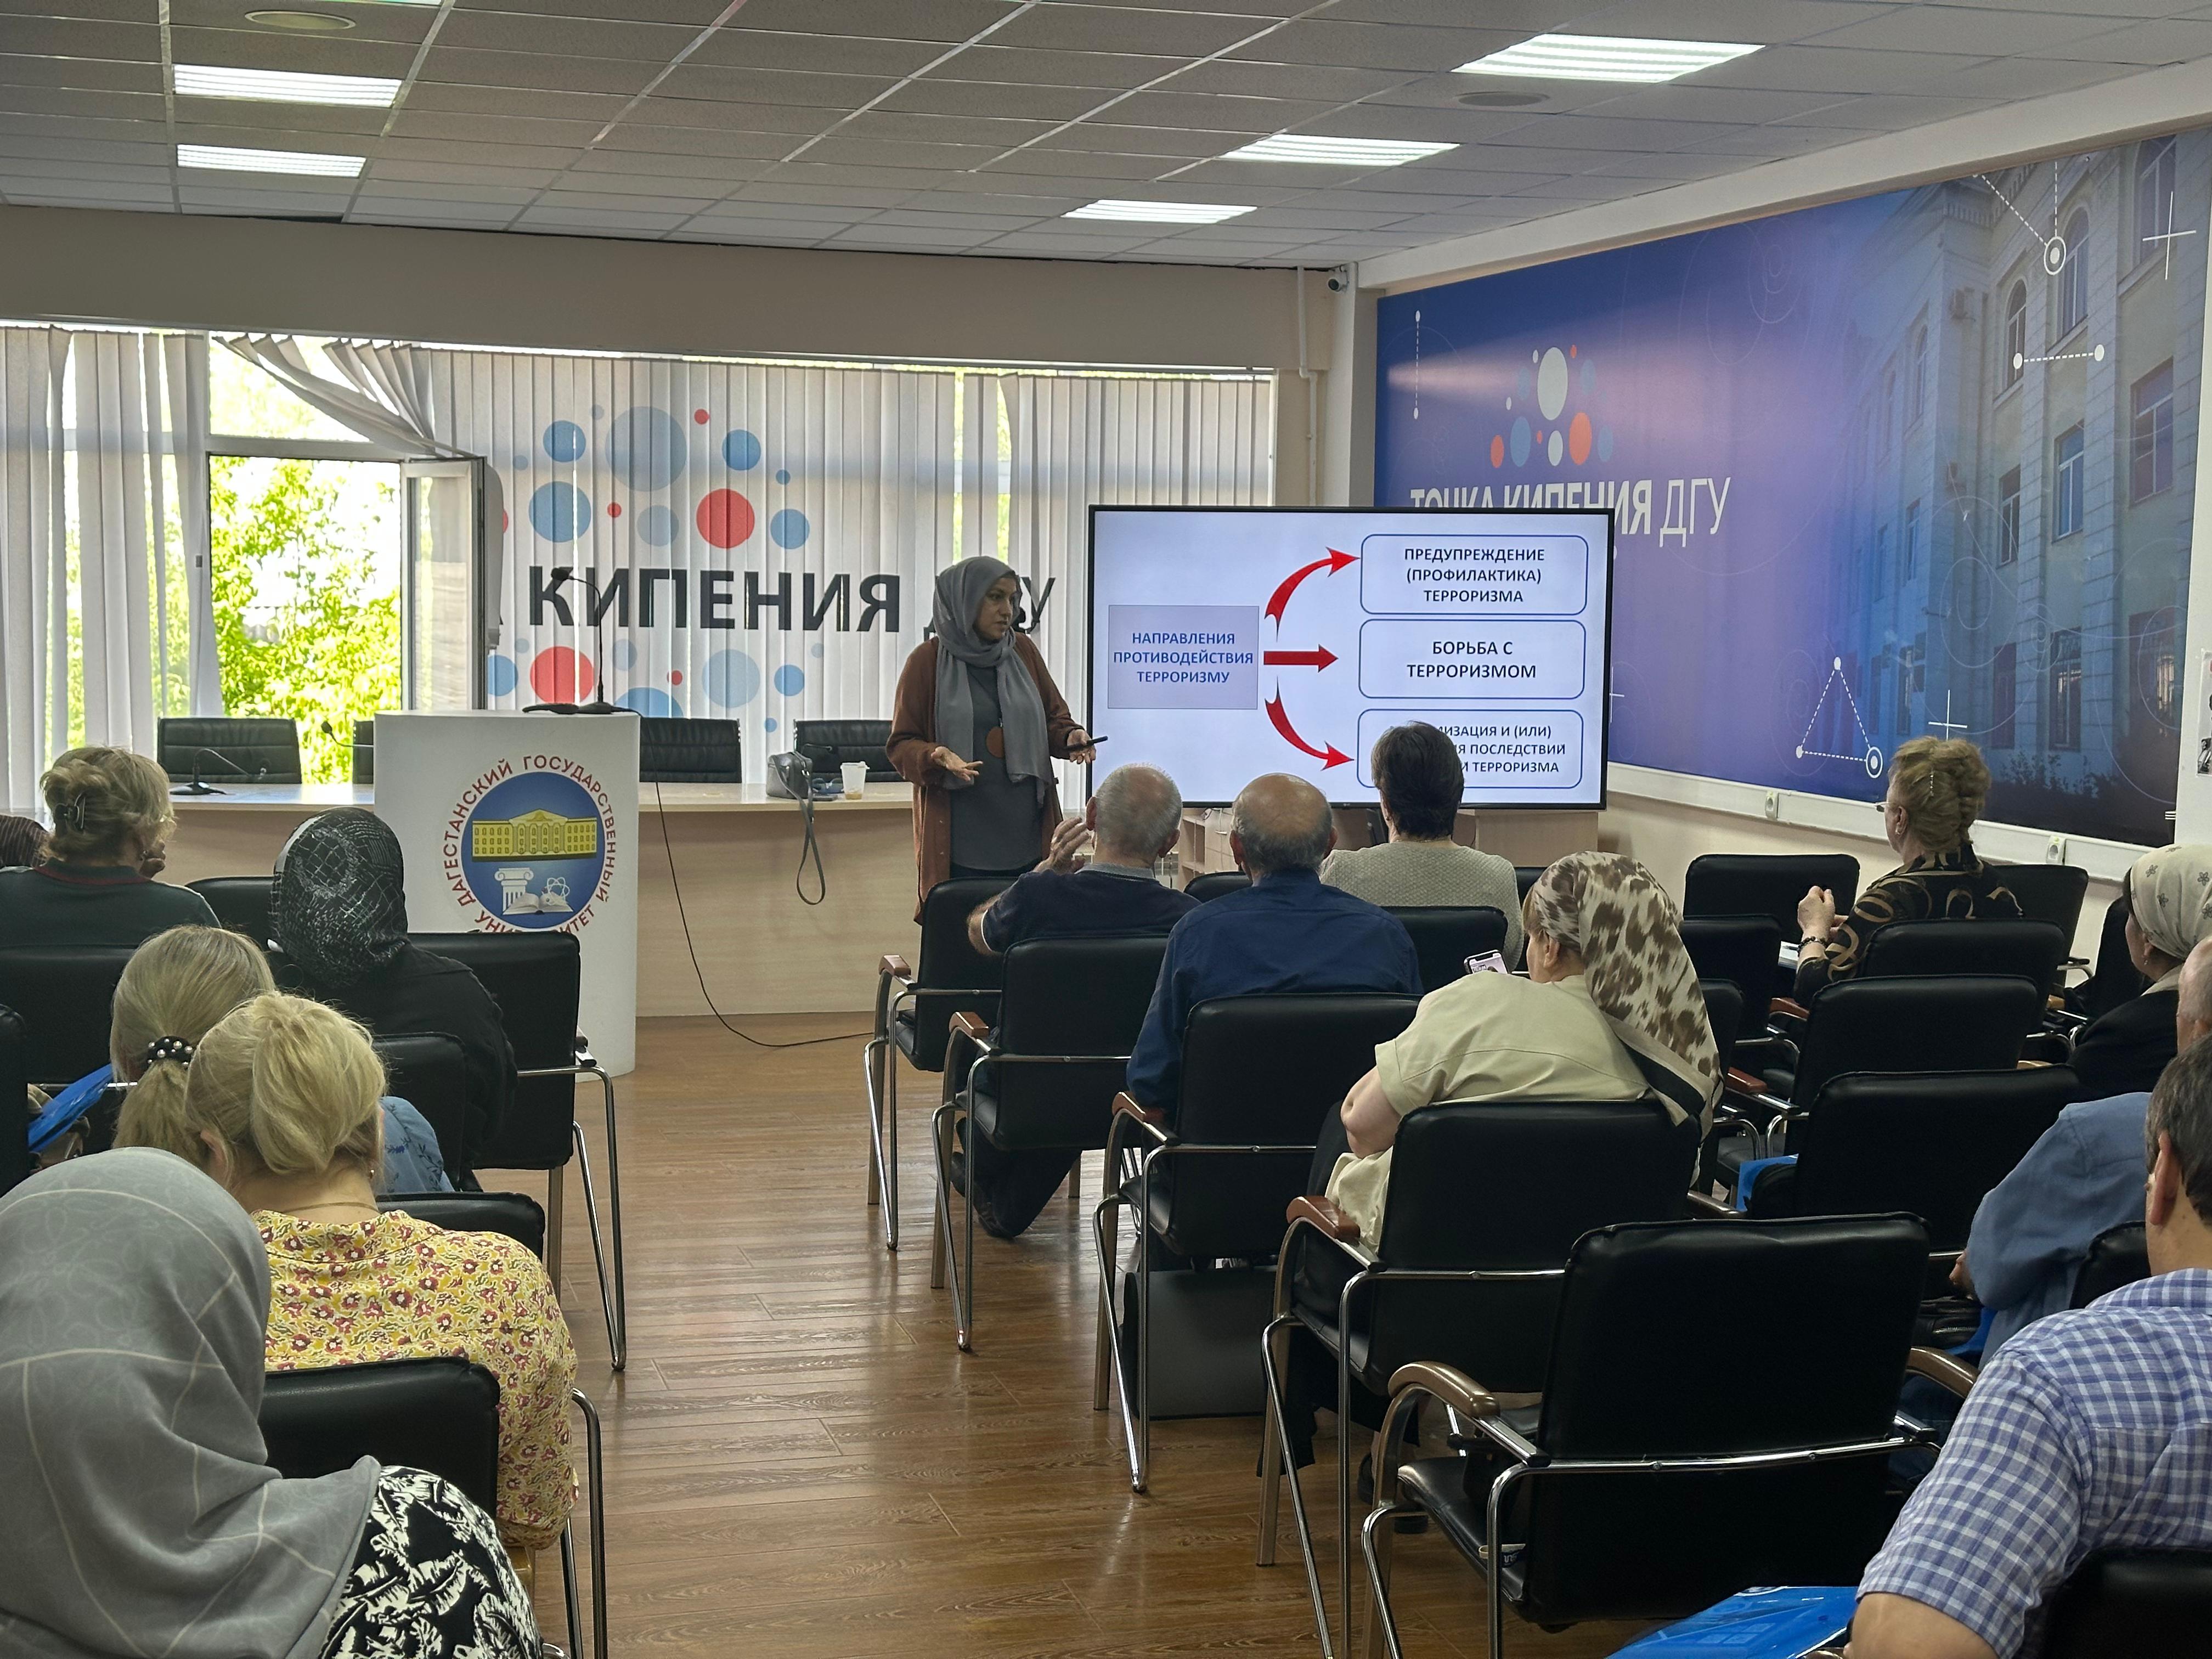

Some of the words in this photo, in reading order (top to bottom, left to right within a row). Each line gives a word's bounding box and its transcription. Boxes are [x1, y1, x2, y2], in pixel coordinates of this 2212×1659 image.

[1660, 477, 1731, 548] ДГУ
[1404, 549, 1545, 563] ПРЕДУПРЕЖДЕНИЕ
[1406, 568, 1542, 584] (ПРОФИЛАКТИКА)
[530, 566, 900, 632] КИПЕНИЯ
[1424, 590, 1523, 602] ТЕРРОРИЗМА
[1132, 633, 1235, 645] НАПРАВЛЕНИЯ
[1432, 641, 1499, 655] БОРЬБА
[1503, 641, 1513, 655] С
[1113, 650, 1254, 666] ПРОТИВОДЕЙСТВИЯ
[1137, 670, 1229, 684] ТЕРРОРИЗМУ
[1407, 664, 1536, 679] ТЕРРОРИЗМОМ
[1501, 726, 1510, 737] И
[1514, 725, 1551, 739] (ИЛИ)
[1472, 761, 1559, 773] ТЕРРОРИЗМА
[443, 758, 513, 906] ДАГЕСТАНСКИЙ
[523, 755, 616, 902] ГОСУДАРСТВЕННЫЙ
[475, 905, 595, 933] УНИТЕТ
